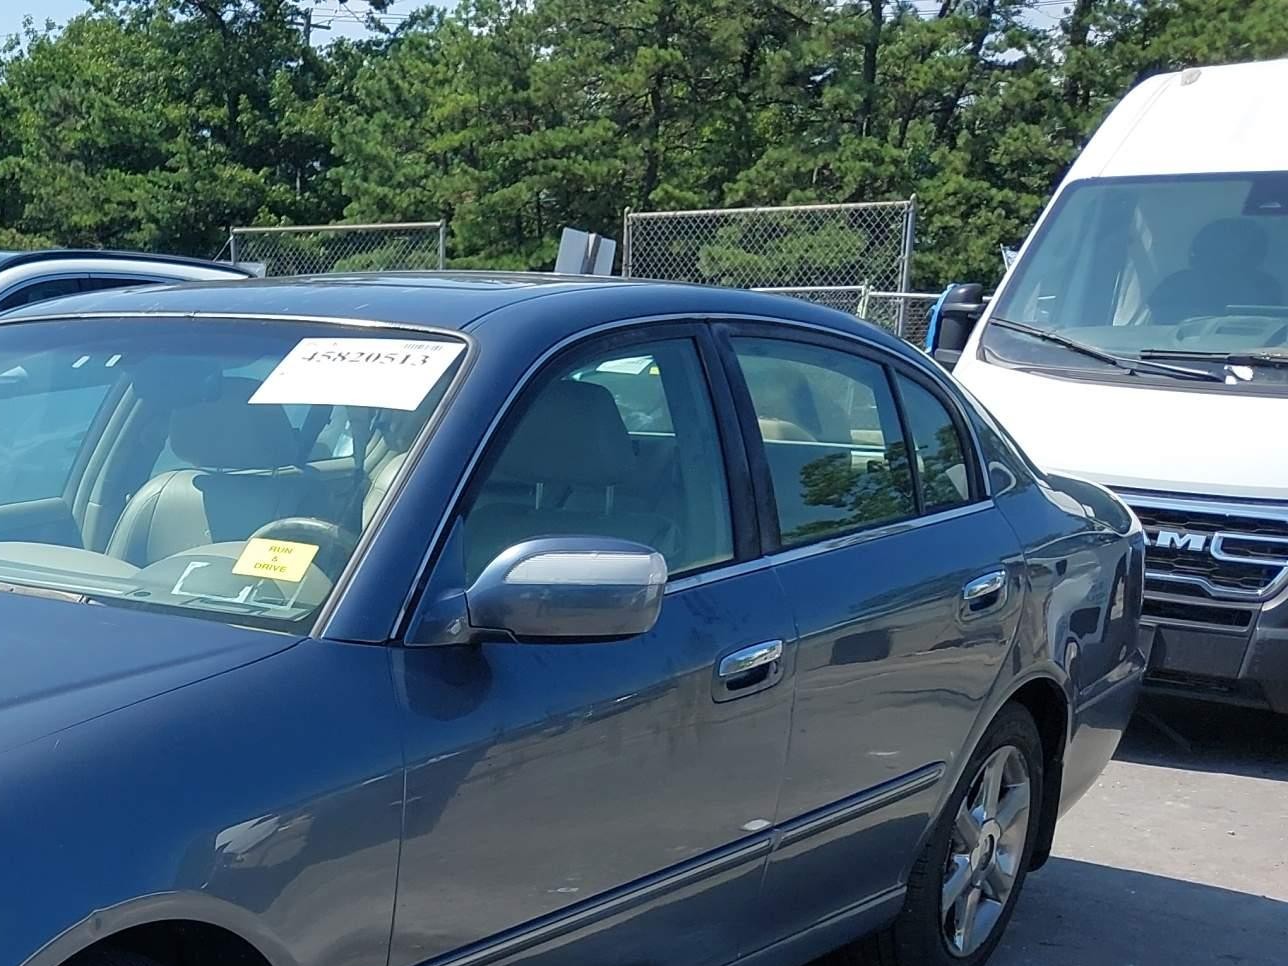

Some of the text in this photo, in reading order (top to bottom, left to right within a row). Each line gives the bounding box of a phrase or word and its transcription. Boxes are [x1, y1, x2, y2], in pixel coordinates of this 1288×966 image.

[301, 351, 432, 367] 45820513
[269, 545, 294, 554] RUN
[254, 562, 288, 573] DRIVE
